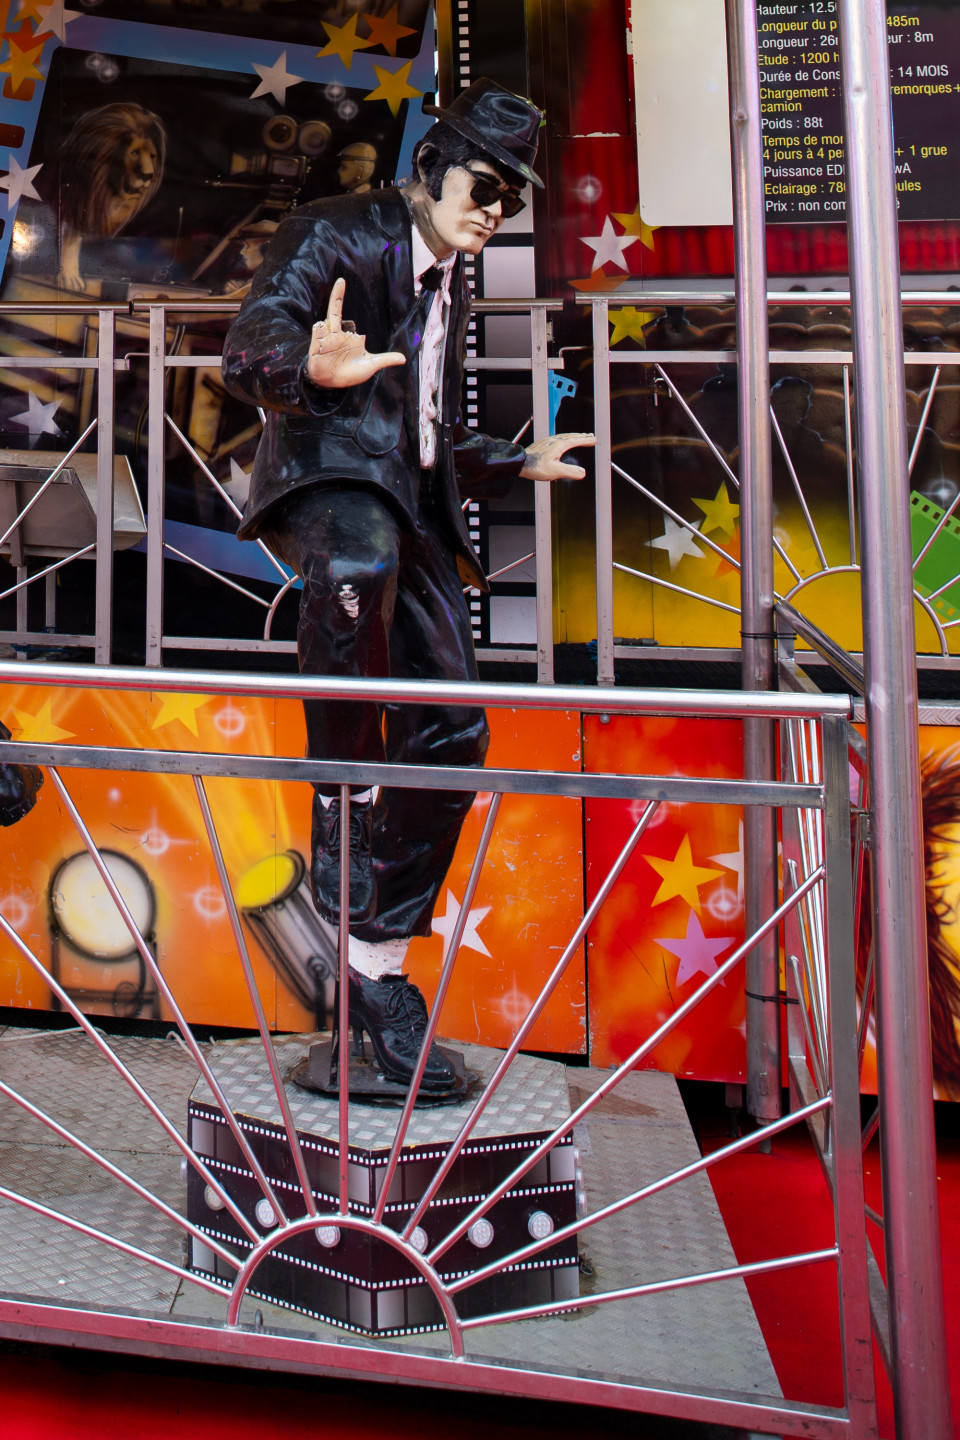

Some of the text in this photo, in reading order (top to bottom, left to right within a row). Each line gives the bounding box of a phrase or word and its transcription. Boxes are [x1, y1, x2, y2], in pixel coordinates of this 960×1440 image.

[809, 1, 837, 13] 12.5
[812, 19, 826, 30] du
[914, 31, 934, 43] 8m
[800, 52, 830, 64] 1200
[759, 70, 792, 82] Durée
[795, 69, 809, 81] de
[897, 66, 913, 77] 14
[916, 64, 949, 77] MOIS
[760, 86, 829, 100] Chargement
[760, 100, 802, 112] camion
[761, 118, 793, 130] Poids
[804, 116, 823, 128] 88t
[762, 135, 800, 148] Temps
[804, 134, 818, 145] de
[762, 149, 770, 160] 4
[774, 148, 803, 162] jours
[806, 147, 813, 159] à
[817, 147, 824, 158] 4
[909, 144, 916, 156] 1
[920, 146, 948, 158] grue
[764, 166, 823, 177] Puissance
[826, 164, 845, 176] ED
[764, 183, 817, 196] Eclairage
[765, 200, 788, 212] Prix
[798, 201, 820, 211] non
